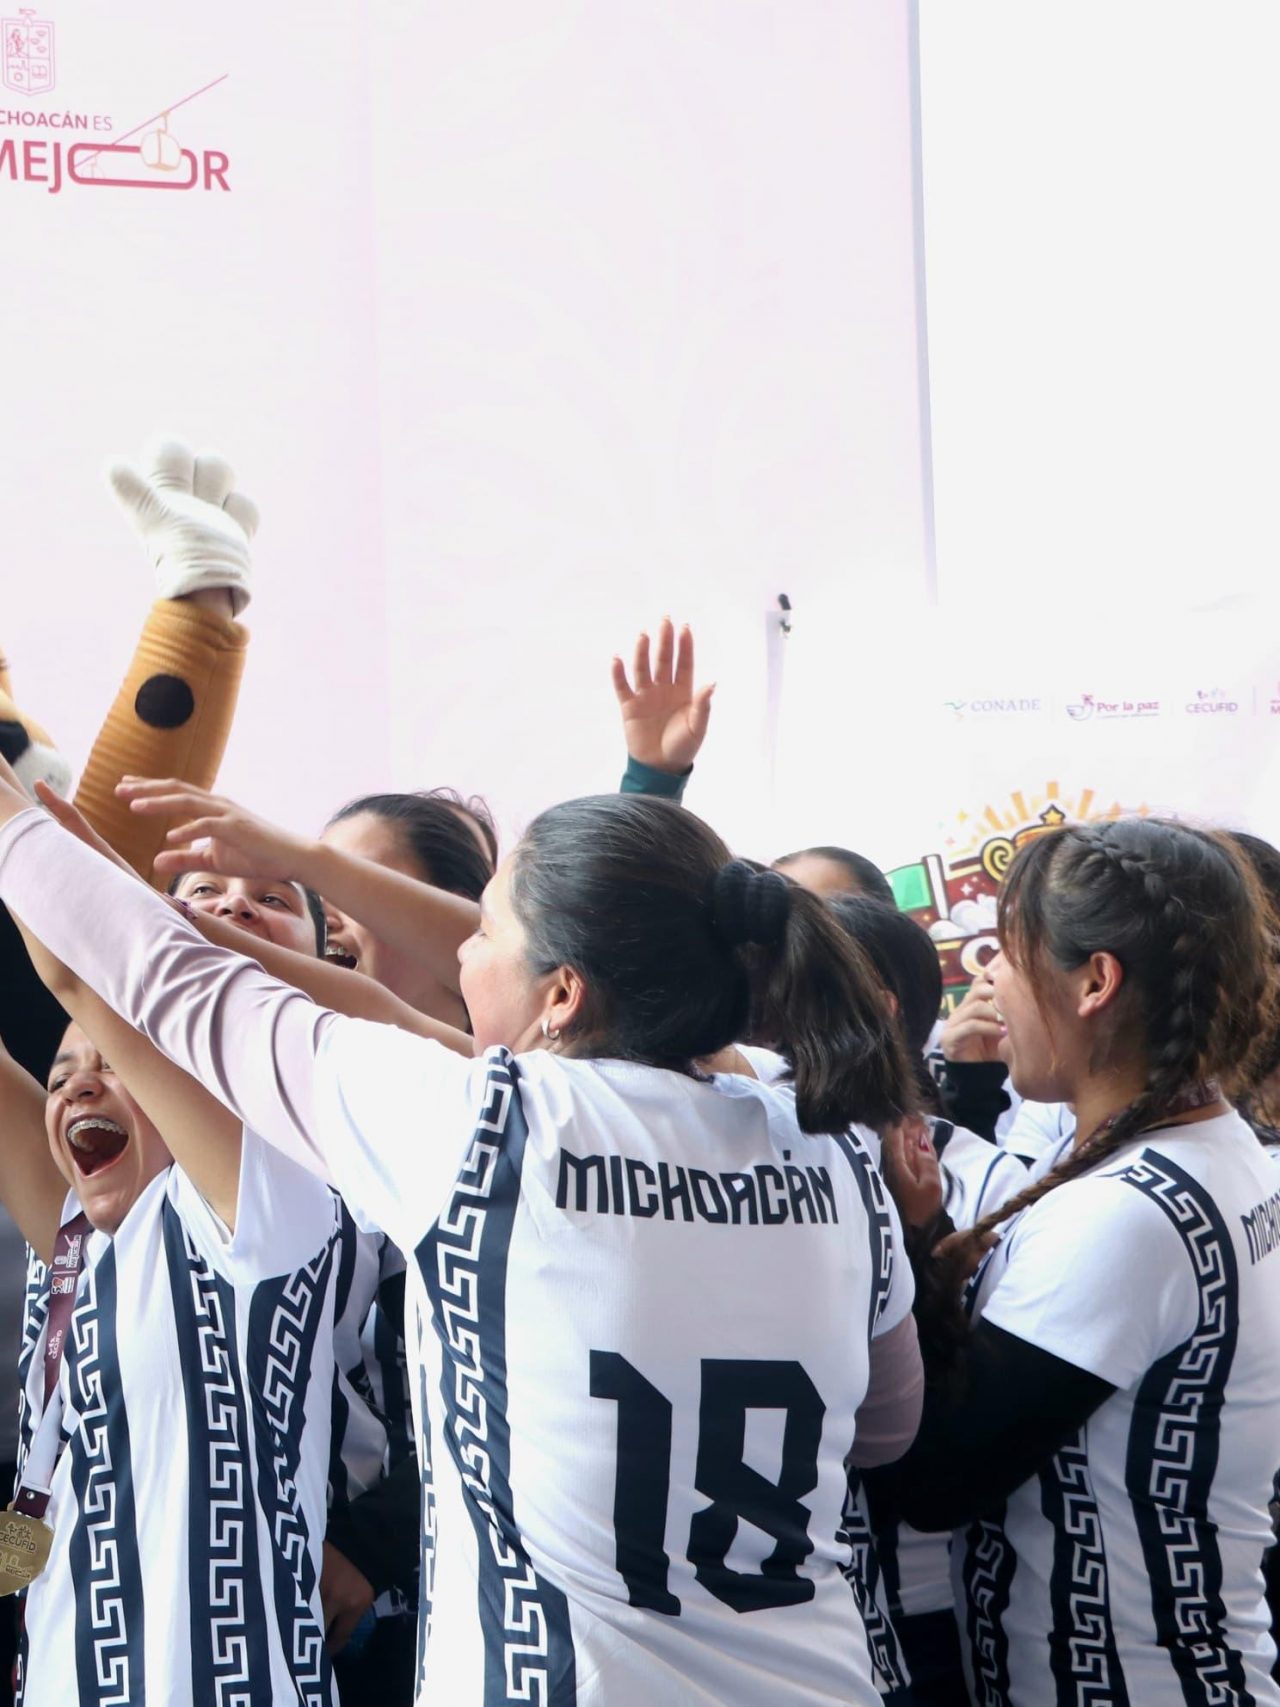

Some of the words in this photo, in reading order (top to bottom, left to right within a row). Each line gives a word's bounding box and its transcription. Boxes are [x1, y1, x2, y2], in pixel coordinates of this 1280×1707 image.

[93, 115, 113, 131] ES
[1185, 702, 1238, 713] CECUFID
[555, 1147, 840, 1226] MICHOACÁN
[589, 1350, 827, 1616] 18
